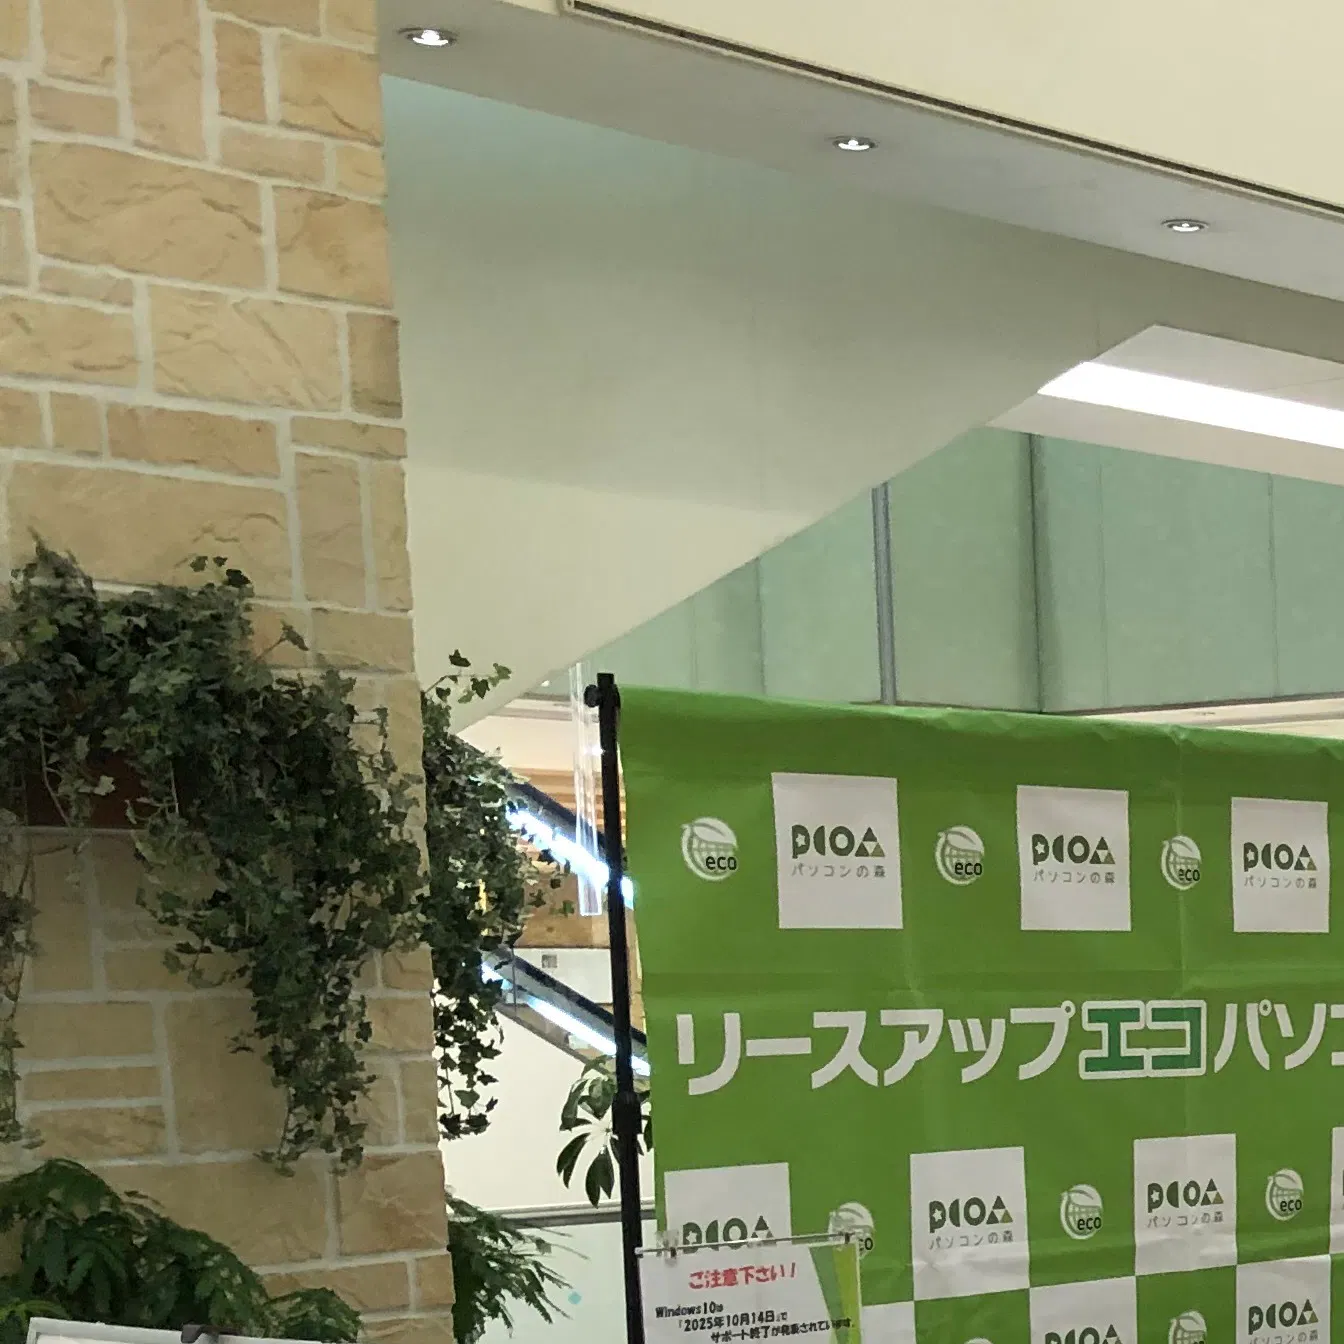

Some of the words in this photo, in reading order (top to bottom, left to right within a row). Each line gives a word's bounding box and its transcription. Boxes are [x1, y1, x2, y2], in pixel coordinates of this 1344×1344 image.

[705, 854, 737, 872] eco
[791, 863, 886, 879] パソコンの森
[954, 861, 983, 877] eco
[1033, 869, 1115, 885] パソコンの森
[1178, 869, 1200, 882] eco
[1244, 876, 1317, 890] パソコンの森
[1279, 1198, 1302, 1213] eco
[1076, 1215, 1102, 1231] eco
[1147, 1211, 1224, 1228] パソコンの森
[928, 1231, 1014, 1251] パソコンの森
